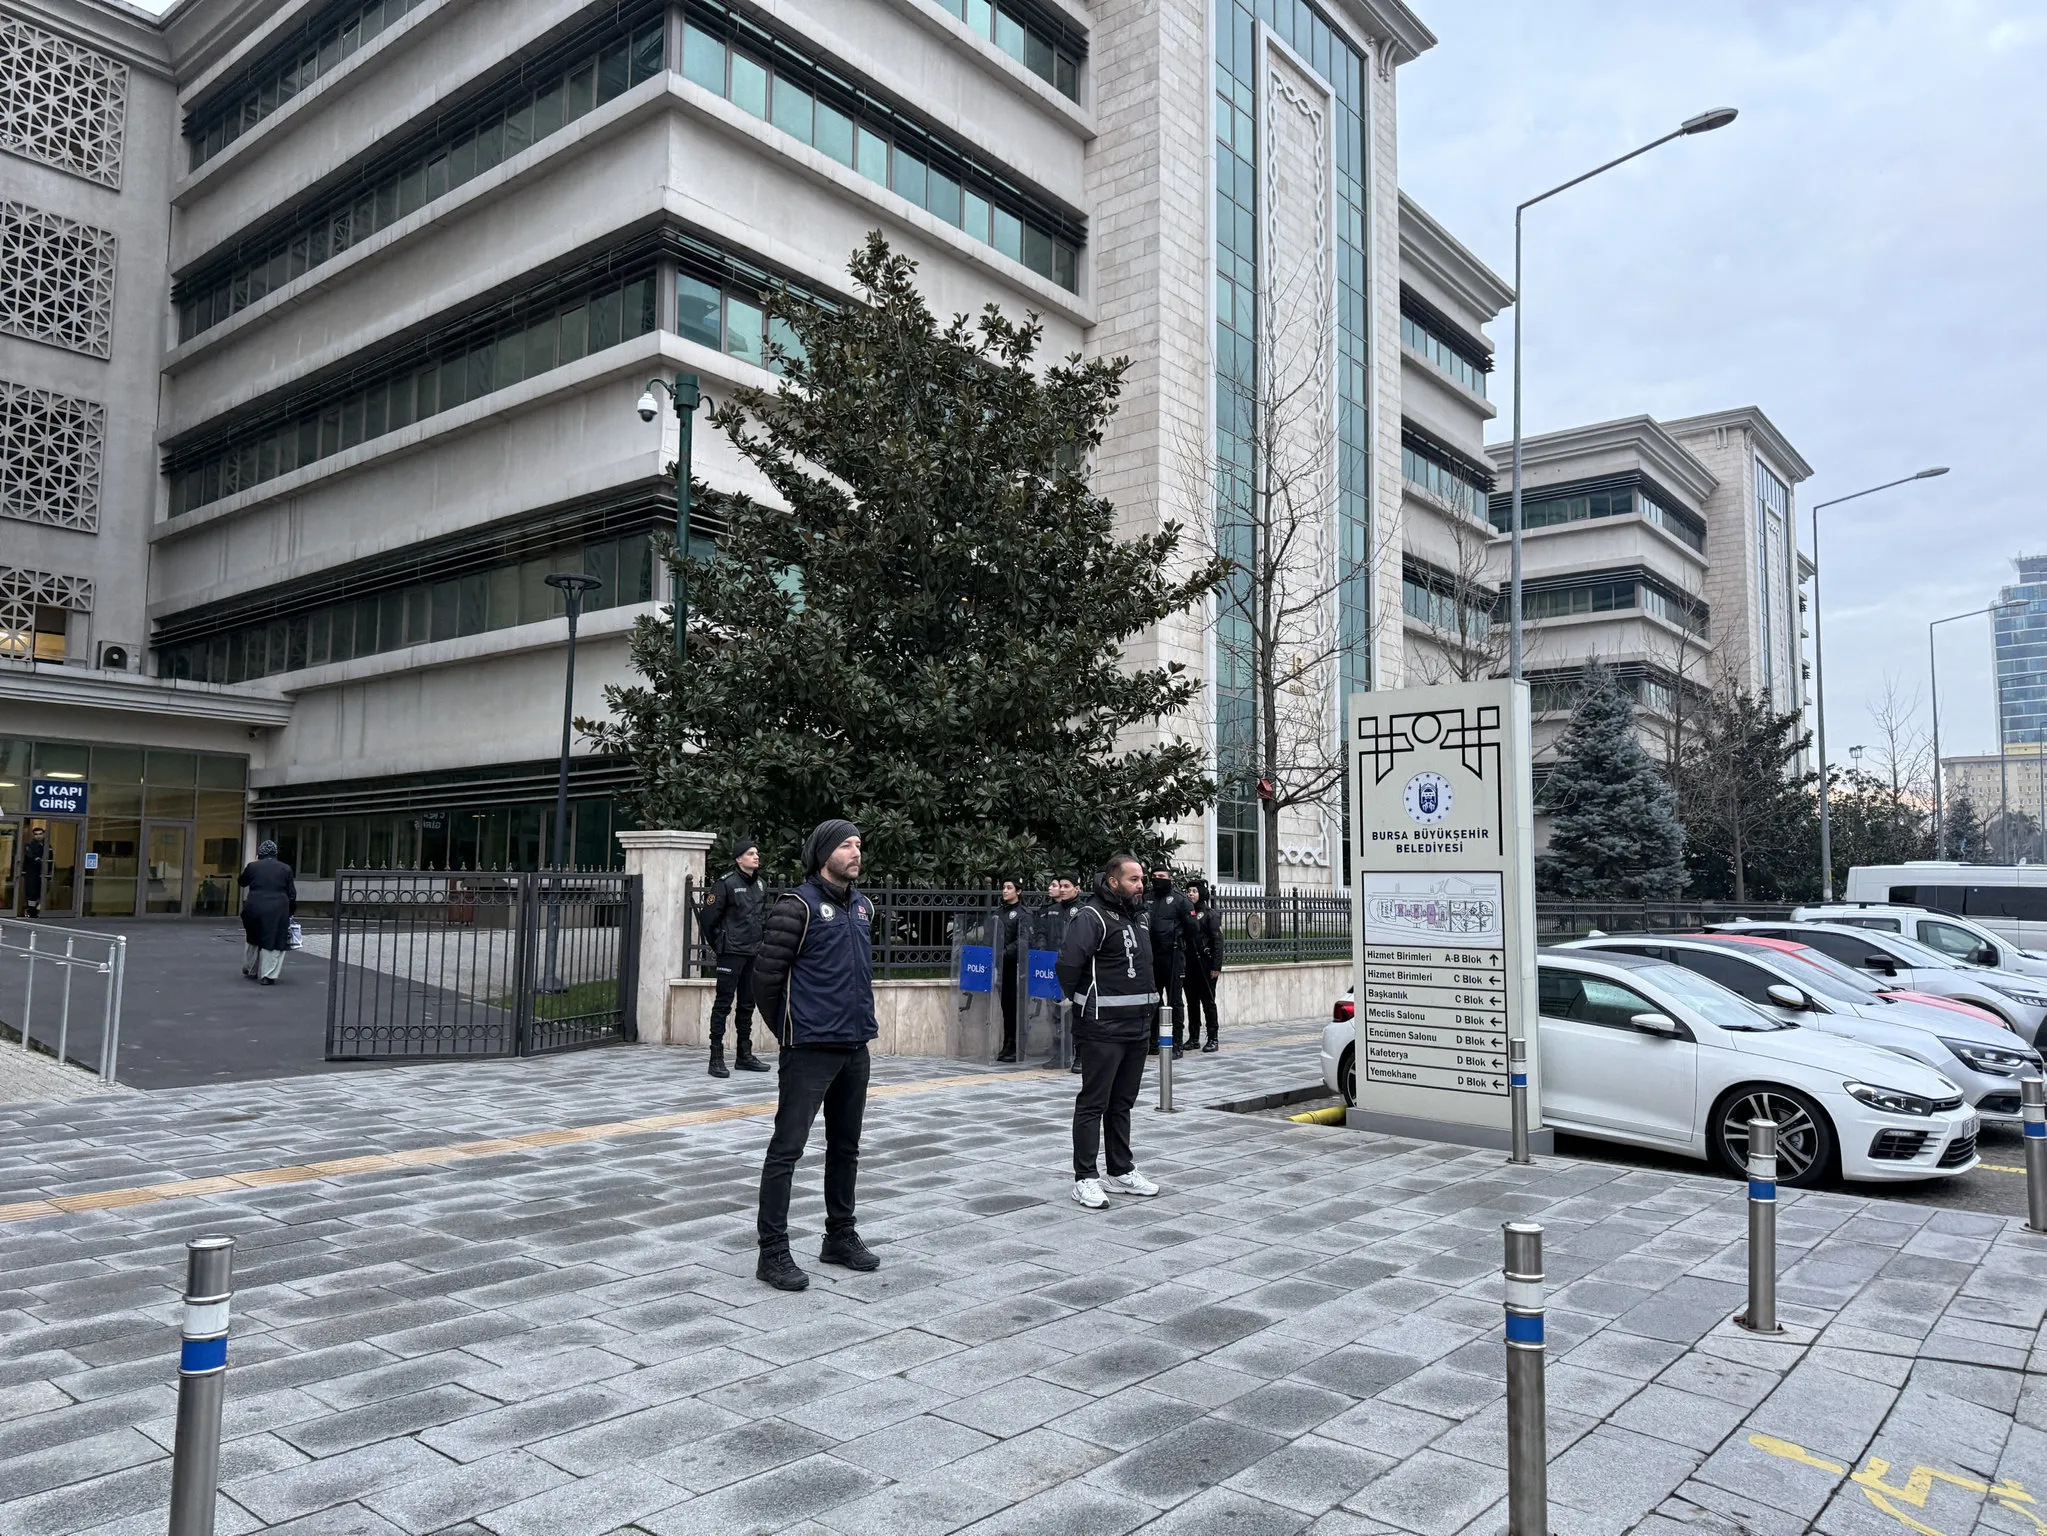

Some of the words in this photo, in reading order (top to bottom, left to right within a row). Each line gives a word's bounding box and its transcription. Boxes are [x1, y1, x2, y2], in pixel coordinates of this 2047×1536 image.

[35, 785, 45, 795] C
[49, 785, 82, 797] KAPI
[39, 796, 77, 812] GİRİŞ
[1372, 830, 1408, 841] BURSA
[1414, 827, 1489, 841] BÜYÜKŞEHİR
[1396, 841, 1463, 853] BELEDİYESİ
[1367, 950, 1394, 960] Hizmet
[1397, 951, 1432, 961] Birimleri
[1445, 954, 1460, 963] A-B
[1462, 954, 1482, 964] Blok
[967, 963, 985, 973] POLİS
[1035, 968, 1054, 979] POLİS
[1368, 970, 1395, 979] Hizmet
[1397, 971, 1433, 981] Birimleri
[1454, 974, 1460, 983] C
[1462, 974, 1482, 984] Blok
[1368, 989, 1408, 1000] Başkanlık
[1455, 995, 1461, 1003] C
[1464, 995, 1484, 1005] Blok
[1369, 1008, 1395, 1018] Meclis
[1397, 1010, 1425, 1021] Salonu
[1455, 1015, 1462, 1023] D
[1465, 1015, 1484, 1025] Blok
[1369, 1028, 1406, 1039] Encümen
[1408, 1031, 1437, 1042] Salonu
[1456, 1035, 1463, 1044] D
[1465, 1036, 1485, 1046] Blok
[1370, 1047, 1409, 1060] Kafeterya
[1457, 1056, 1463, 1064] D
[1466, 1056, 1486, 1067] Blok
[1370, 1067, 1417, 1080] Yemekhane
[1457, 1076, 1464, 1085] D
[1466, 1077, 1487, 1088] Blok
